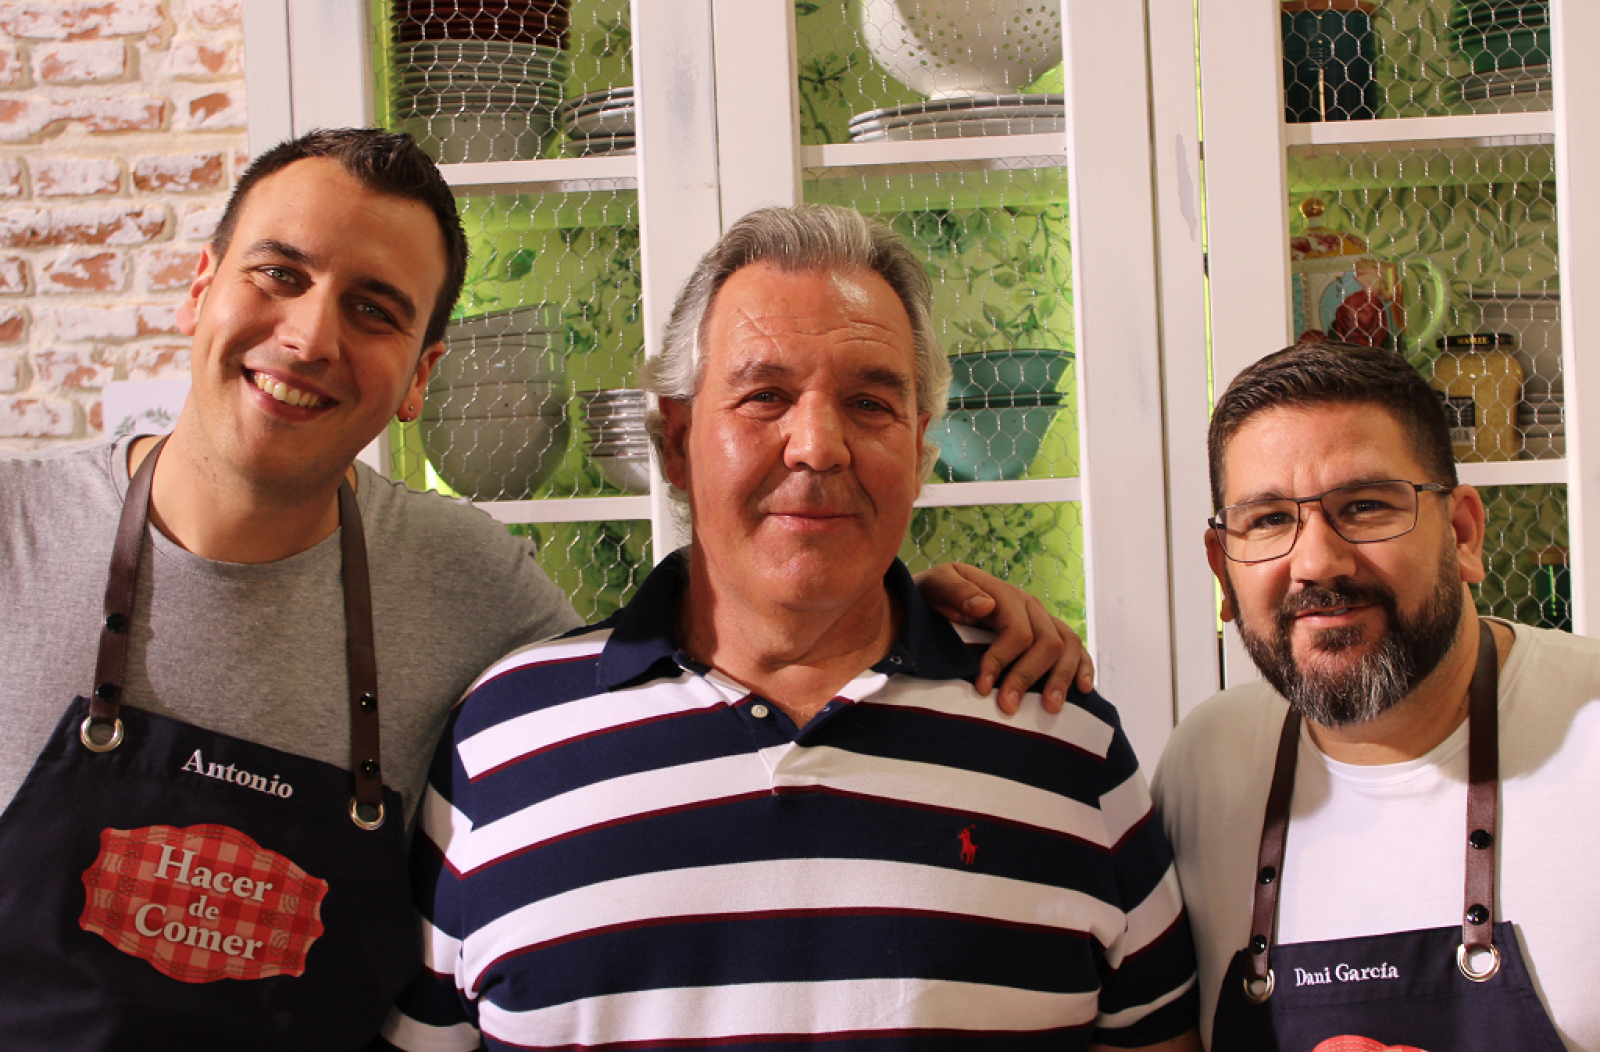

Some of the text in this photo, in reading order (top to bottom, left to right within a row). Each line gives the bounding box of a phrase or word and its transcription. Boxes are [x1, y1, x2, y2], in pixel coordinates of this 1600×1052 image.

[181, 749, 293, 798] Antonio
[153, 844, 273, 902] Hacer
[135, 904, 263, 959] Comer
[188, 896, 219, 920] de
[1294, 962, 1399, 987] Dani García
